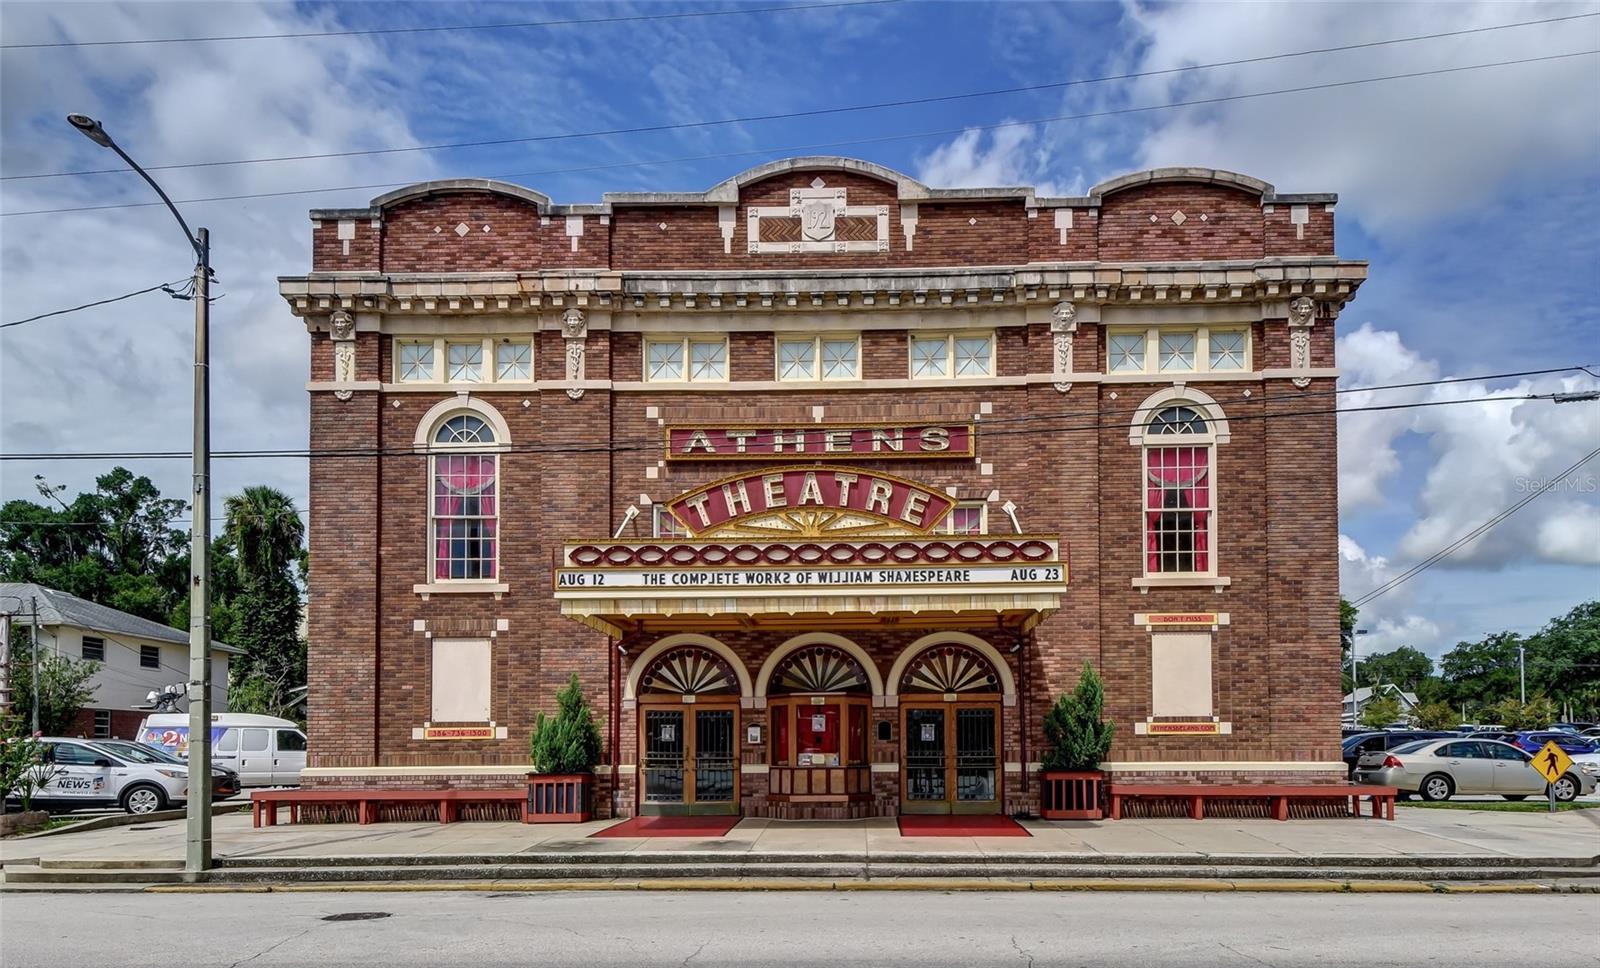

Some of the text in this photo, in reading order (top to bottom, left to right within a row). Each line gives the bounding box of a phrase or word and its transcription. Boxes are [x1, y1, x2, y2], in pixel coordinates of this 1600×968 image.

[684, 428, 951, 453] ATHENS
[685, 471, 931, 527] THEATRE
[559, 573, 605, 586] AUG 12
[642, 573, 667, 586] THE
[796, 572, 812, 584] OF
[879, 570, 970, 583] SHAKESPEARE
[1010, 568, 1060, 581] AUG 23
[163, 730, 178, 747] 2
[57, 780, 92, 789] NEWS
